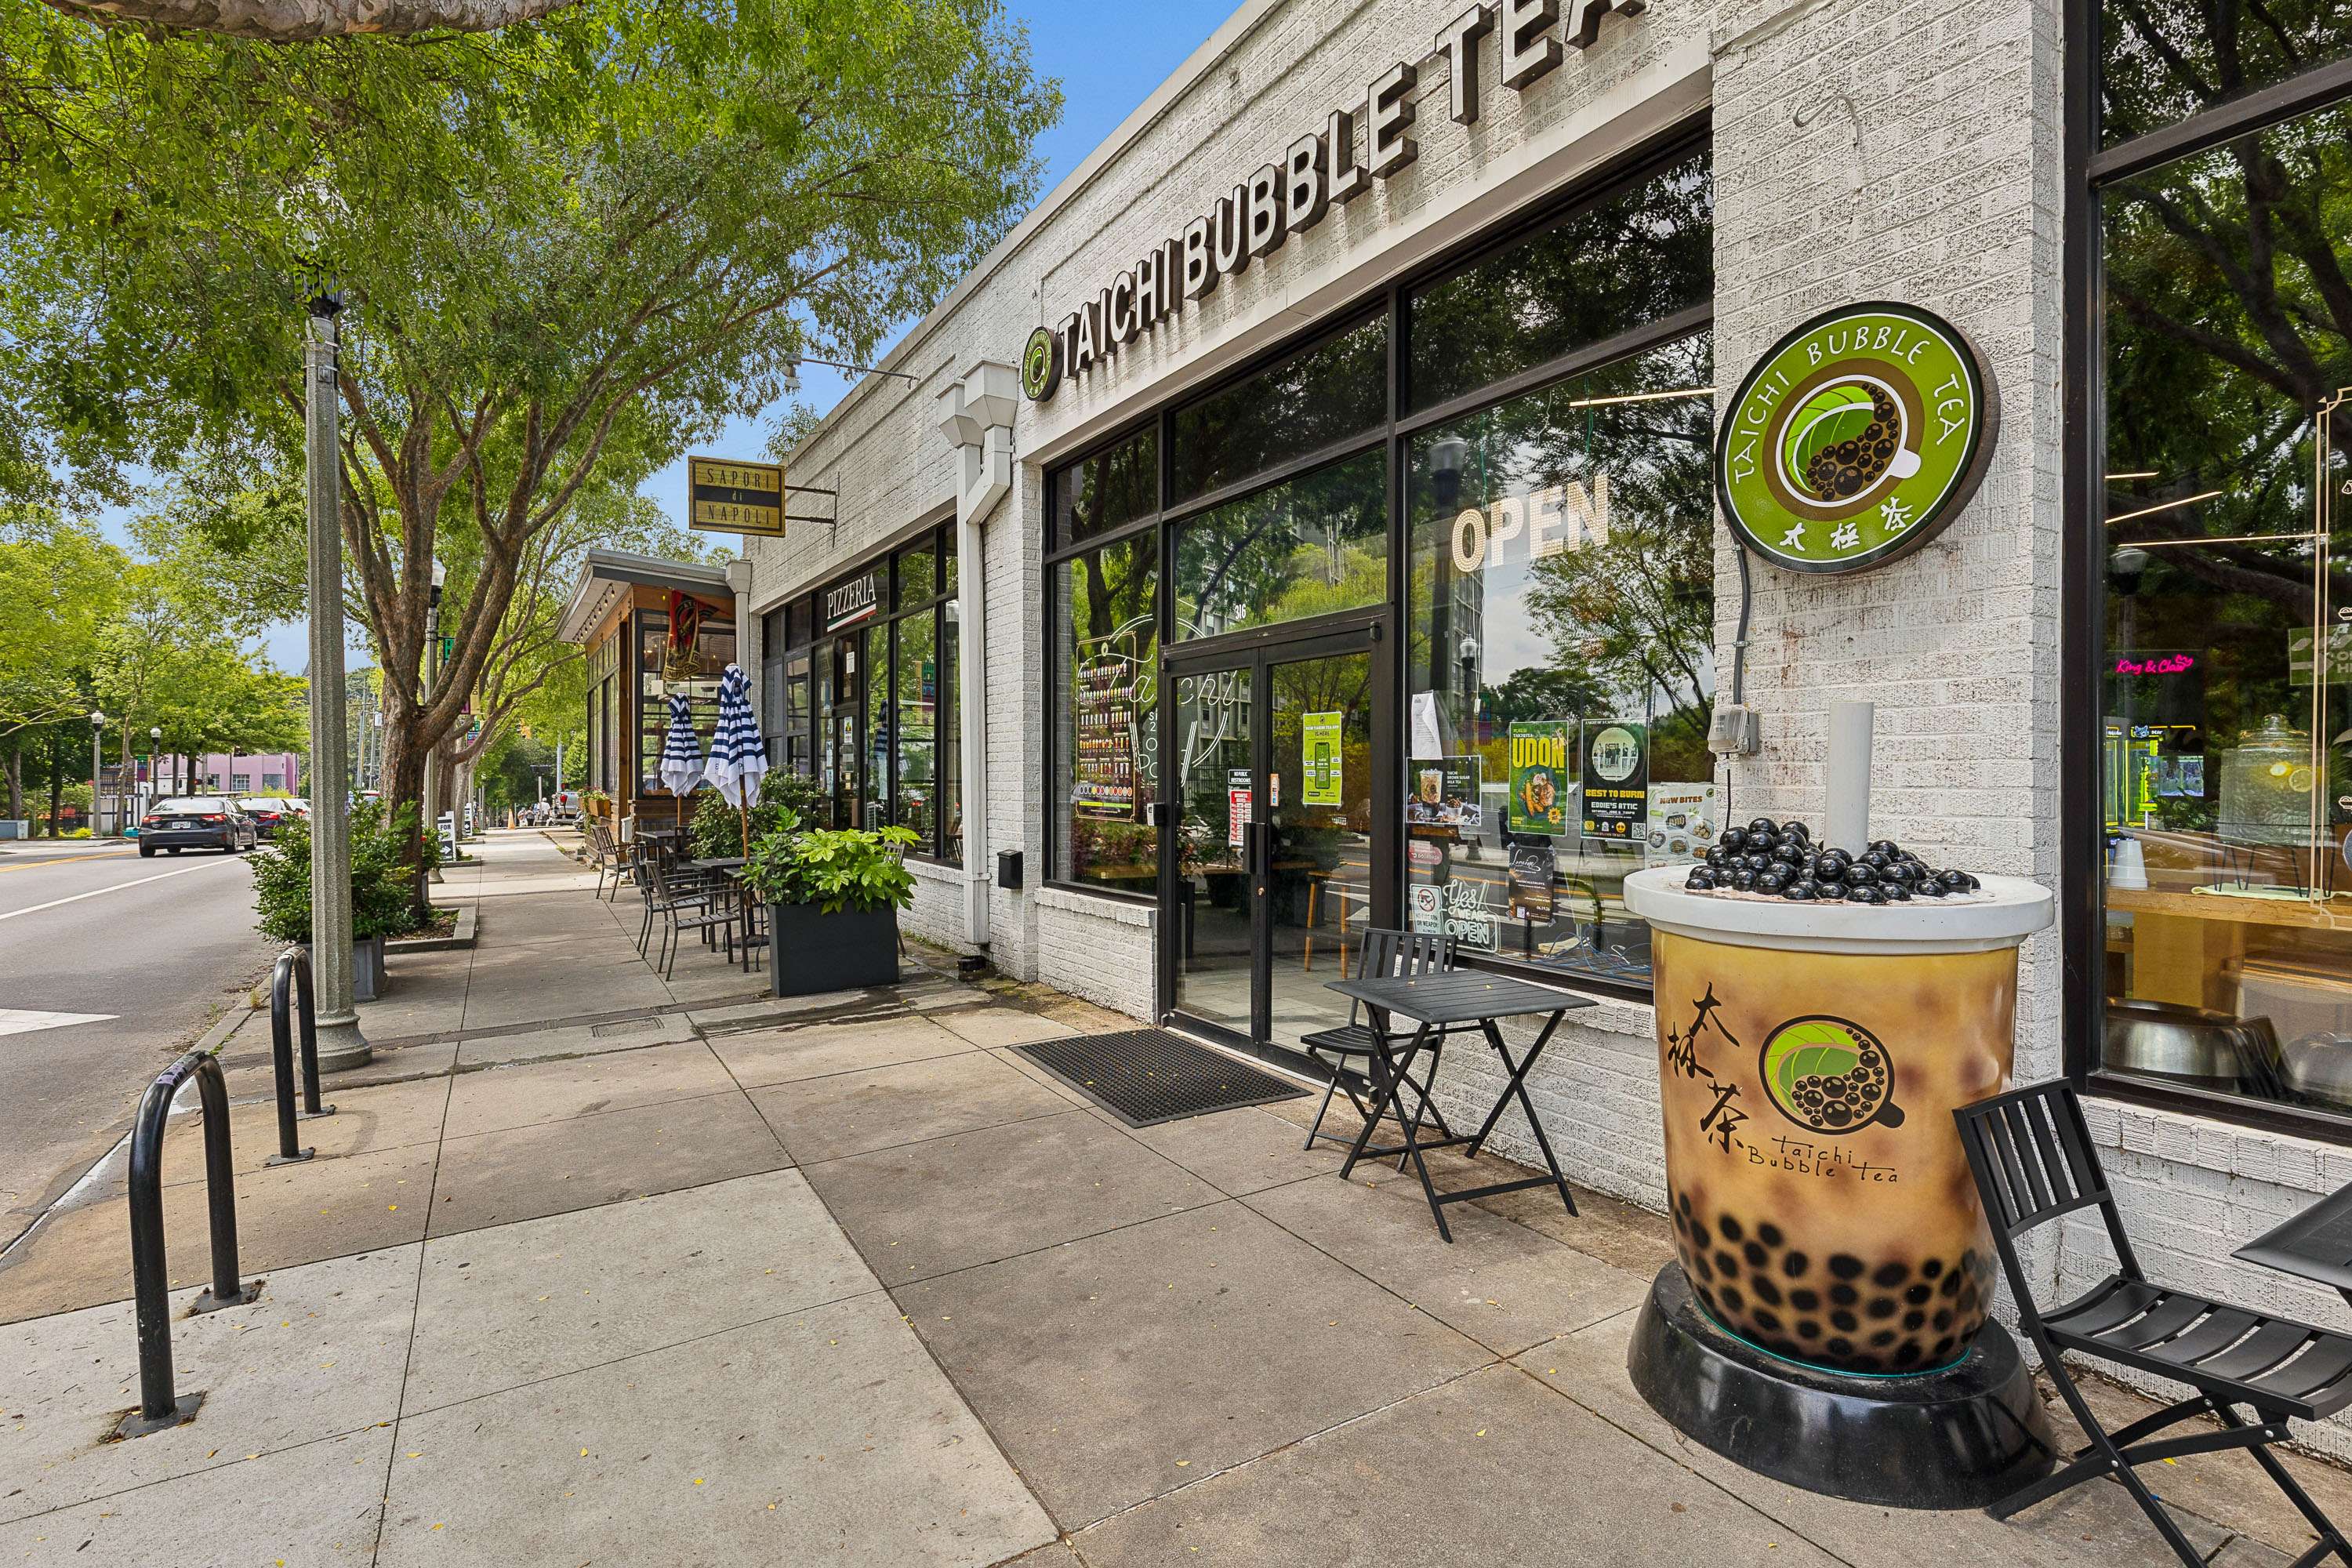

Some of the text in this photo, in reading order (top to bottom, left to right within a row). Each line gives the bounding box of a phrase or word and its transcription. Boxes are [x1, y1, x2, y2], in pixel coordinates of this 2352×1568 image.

[1058, 238, 1181, 379] TAICHI
[1183, 60, 1418, 301] BUBBLE
[1734, 325, 1966, 485] TAICHI BUBBLE TEA
[707, 468, 769, 488] SAPORI
[731, 490, 742, 501] di
[708, 505, 769, 524] NAPOLI
[1452, 474, 1608, 572] OPEN
[827, 572, 877, 619] PIZZERIA
[1235, 603, 1247, 620] 316
[2116, 659, 2143, 676] King
[2145, 660, 2156, 673] &
[1512, 738, 1565, 768] UDON
[1585, 789, 1607, 797] BEST
[1458, 909, 1488, 922] WE ARE
[1444, 918, 1490, 944] OPEN
[1748, 1145, 1898, 1182] Bubble tea
